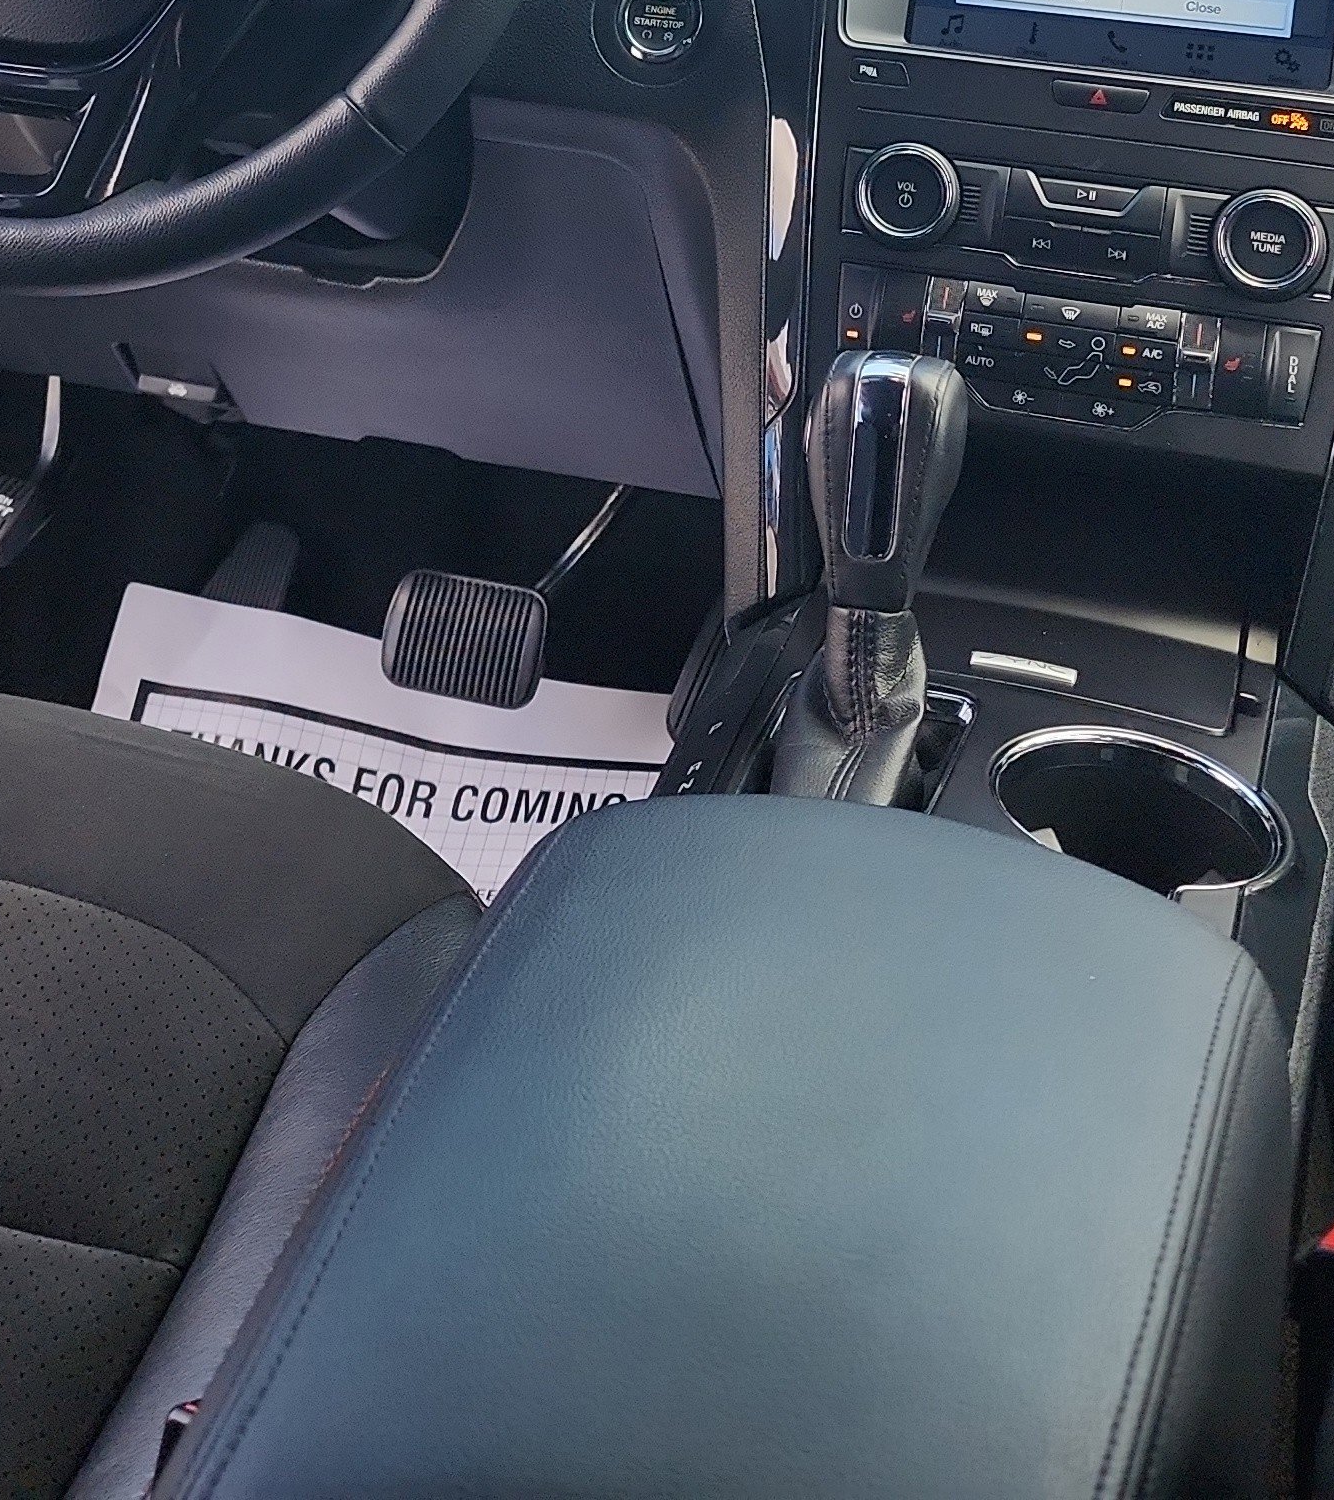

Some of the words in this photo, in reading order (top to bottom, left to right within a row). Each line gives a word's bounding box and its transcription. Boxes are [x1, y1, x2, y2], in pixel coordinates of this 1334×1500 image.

[644, 4, 678, 16] ENGINE
[1185, 0, 1222, 15] Close
[633, 16, 685, 29] START/STOP
[1173, 101, 1225, 117] PASSENGER
[1226, 109, 1260, 122] AIRBAG
[1271, 113, 1289, 126] OFF
[897, 181, 917, 192] VOL
[1250, 231, 1286, 244] MEDIA
[1252, 241, 1282, 254] TUNE
[976, 287, 998, 299] MAX
[1146, 312, 1168, 323] MAX
[1146, 320, 1166, 330] A/C
[1142, 348, 1163, 360] A/C
[965, 354, 995, 368] AUTO
[1287, 355, 1299, 393] DUAL
[352, 766, 438, 820] FOR
